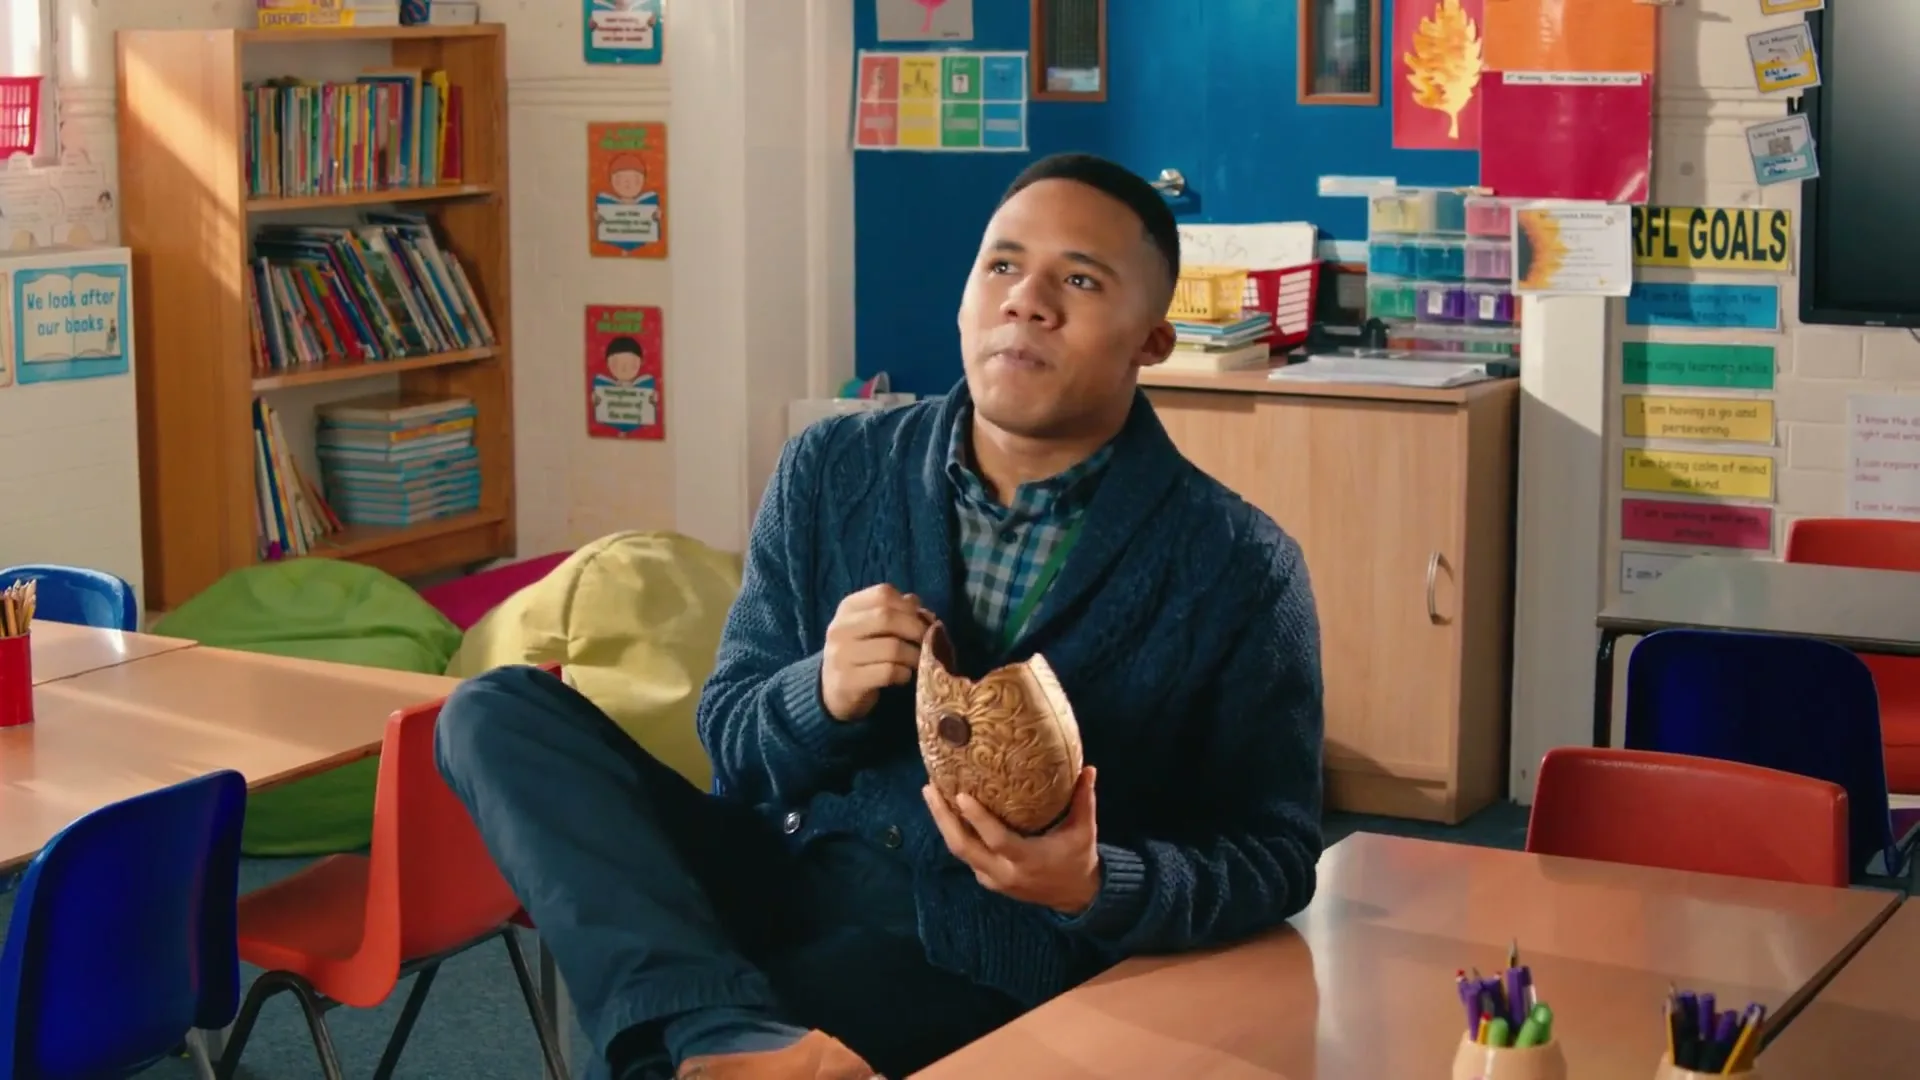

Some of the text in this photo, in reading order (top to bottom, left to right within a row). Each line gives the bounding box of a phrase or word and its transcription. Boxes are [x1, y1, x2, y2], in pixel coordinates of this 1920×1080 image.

[1688, 208, 1788, 263] GOALS
[27, 288, 115, 311] We look after
[38, 322, 60, 336] our
[1655, 361, 1686, 375] using
[1688, 360, 1735, 374] learning
[1640, 402, 1758, 421] I am having a go and
[1629, 455, 1768, 475] I am being calm of mind
[1670, 477, 1692, 489] and
